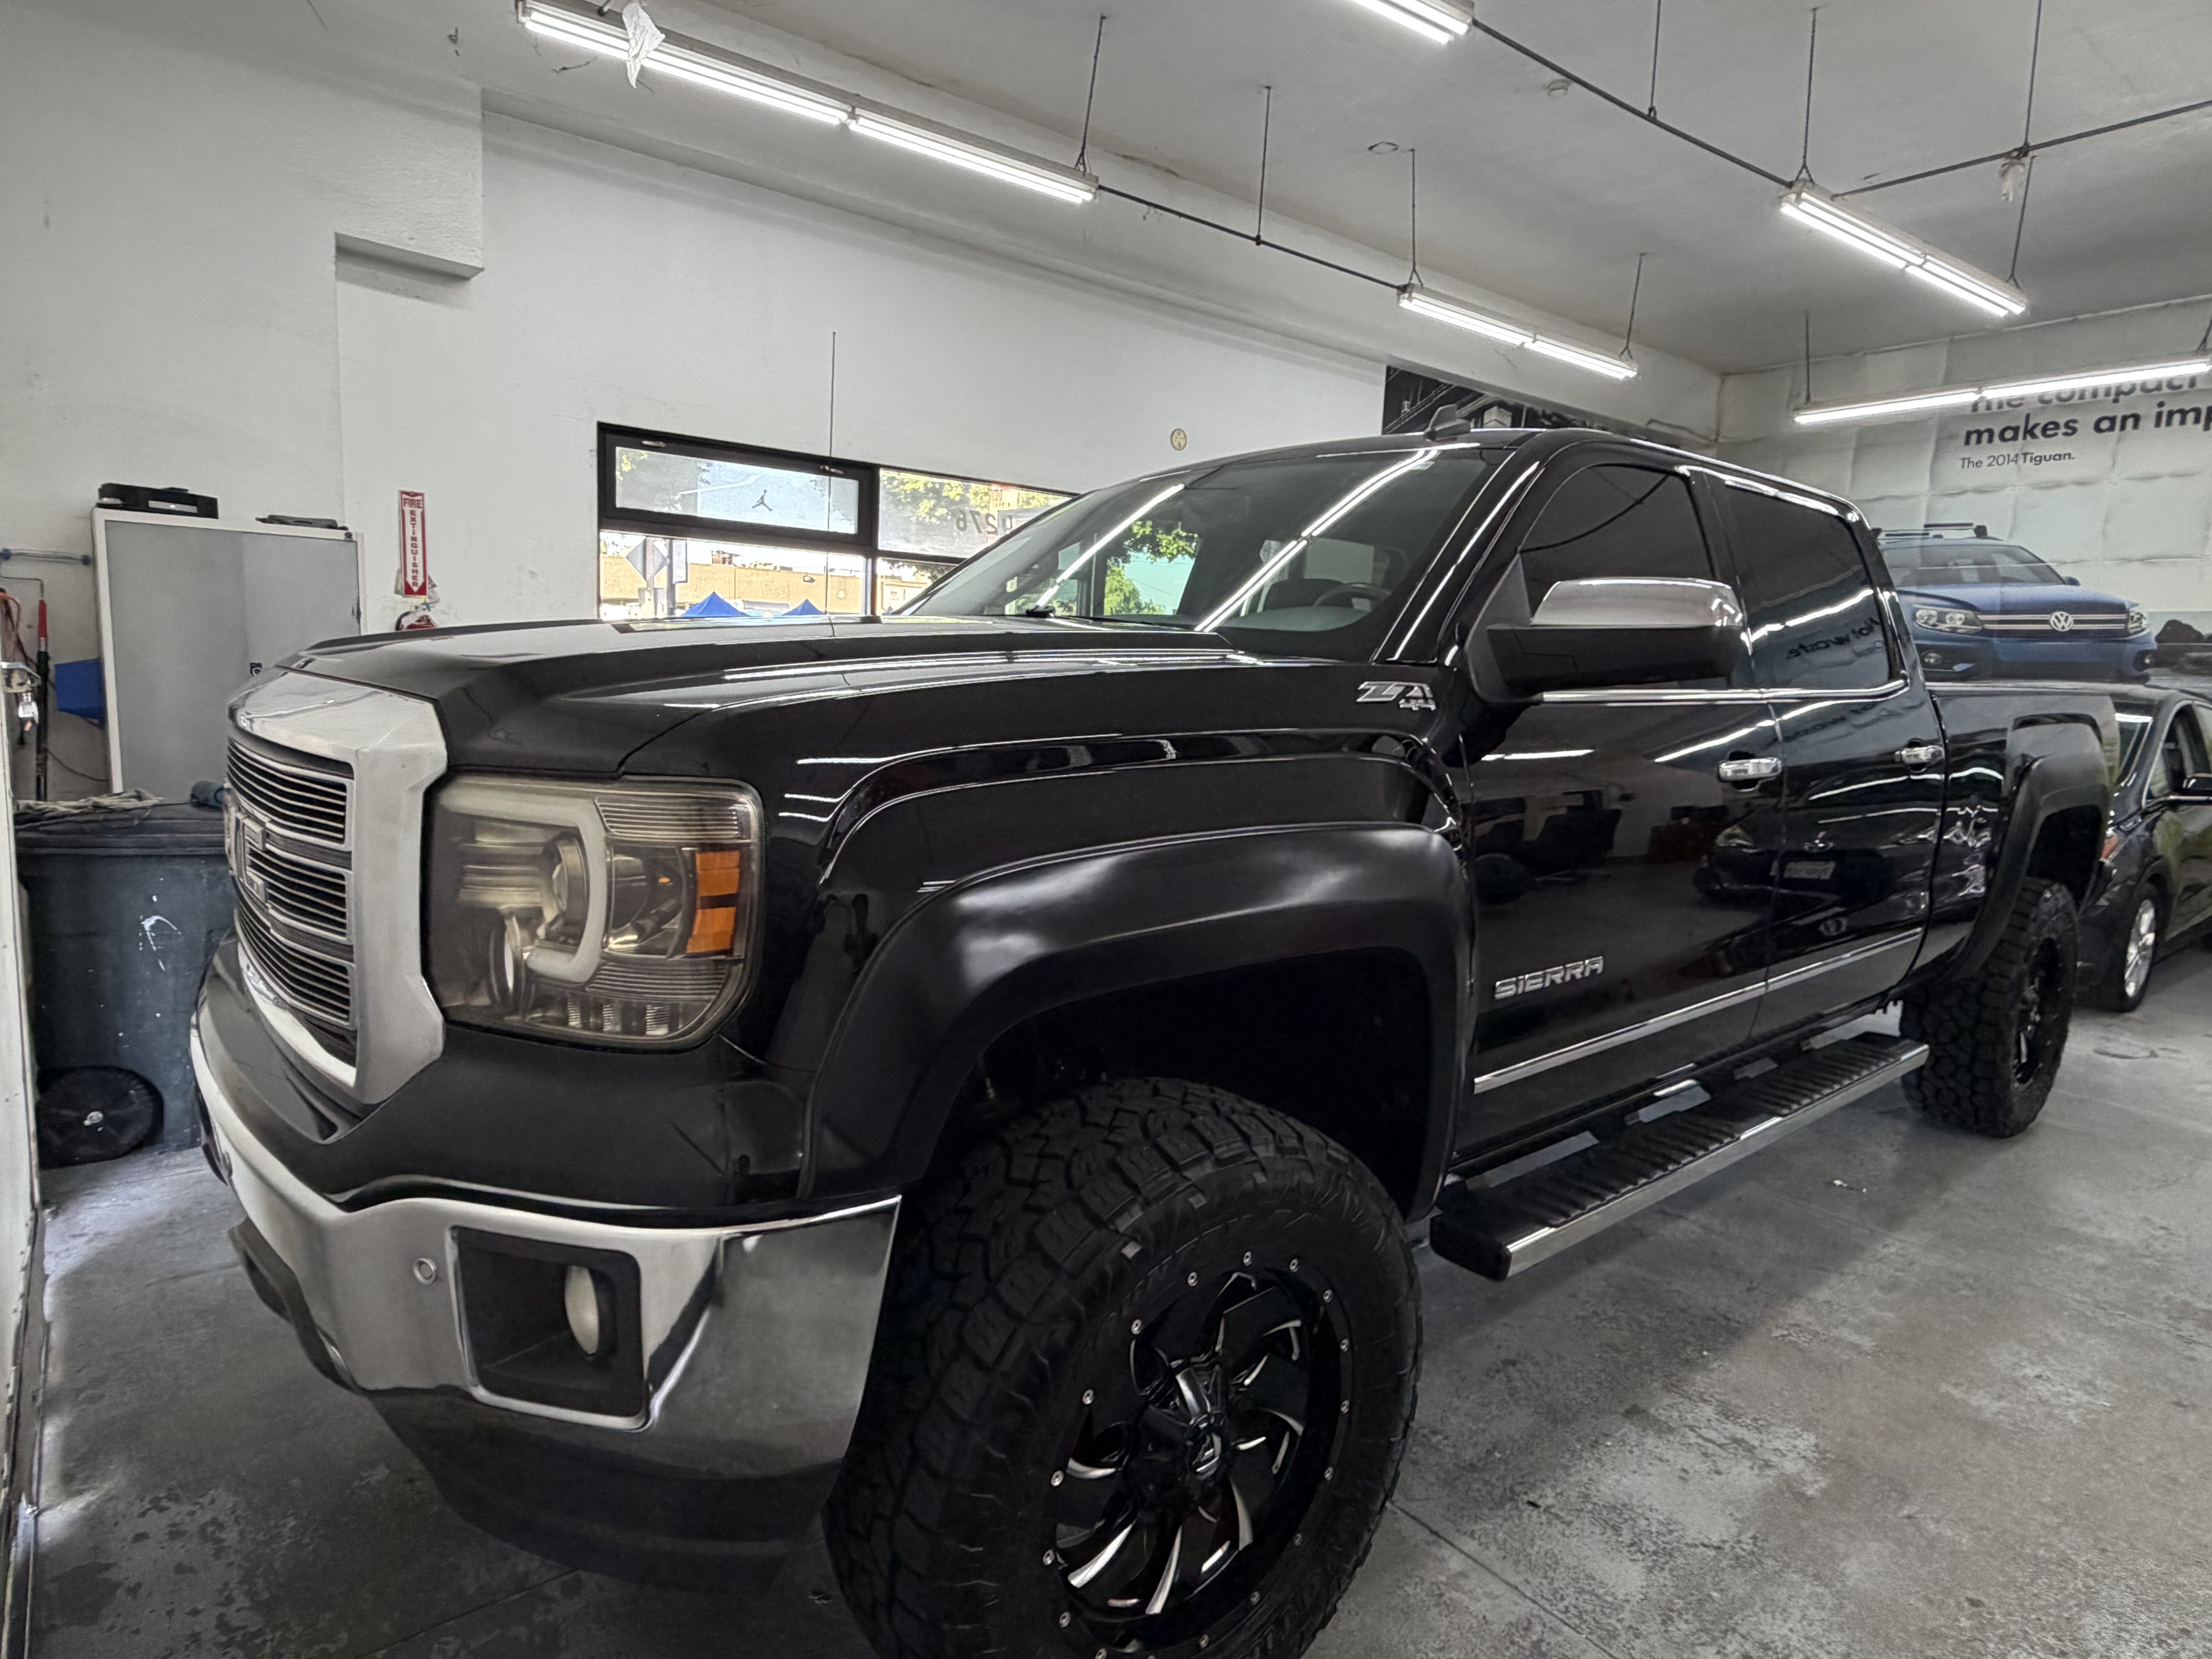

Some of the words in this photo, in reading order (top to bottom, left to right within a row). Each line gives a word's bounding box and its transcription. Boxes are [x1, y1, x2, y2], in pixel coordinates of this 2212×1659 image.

[1964, 413, 2078, 446] makes
[2094, 412, 2141, 434] an
[1960, 457, 1983, 469] The
[1986, 453, 2019, 467] 2014
[2021, 452, 2075, 465] Tiguan.
[403, 498, 422, 508] FIRE
[410, 510, 419, 587] EXTINGUISHER
[1494, 955, 1604, 1001] SIERRA
